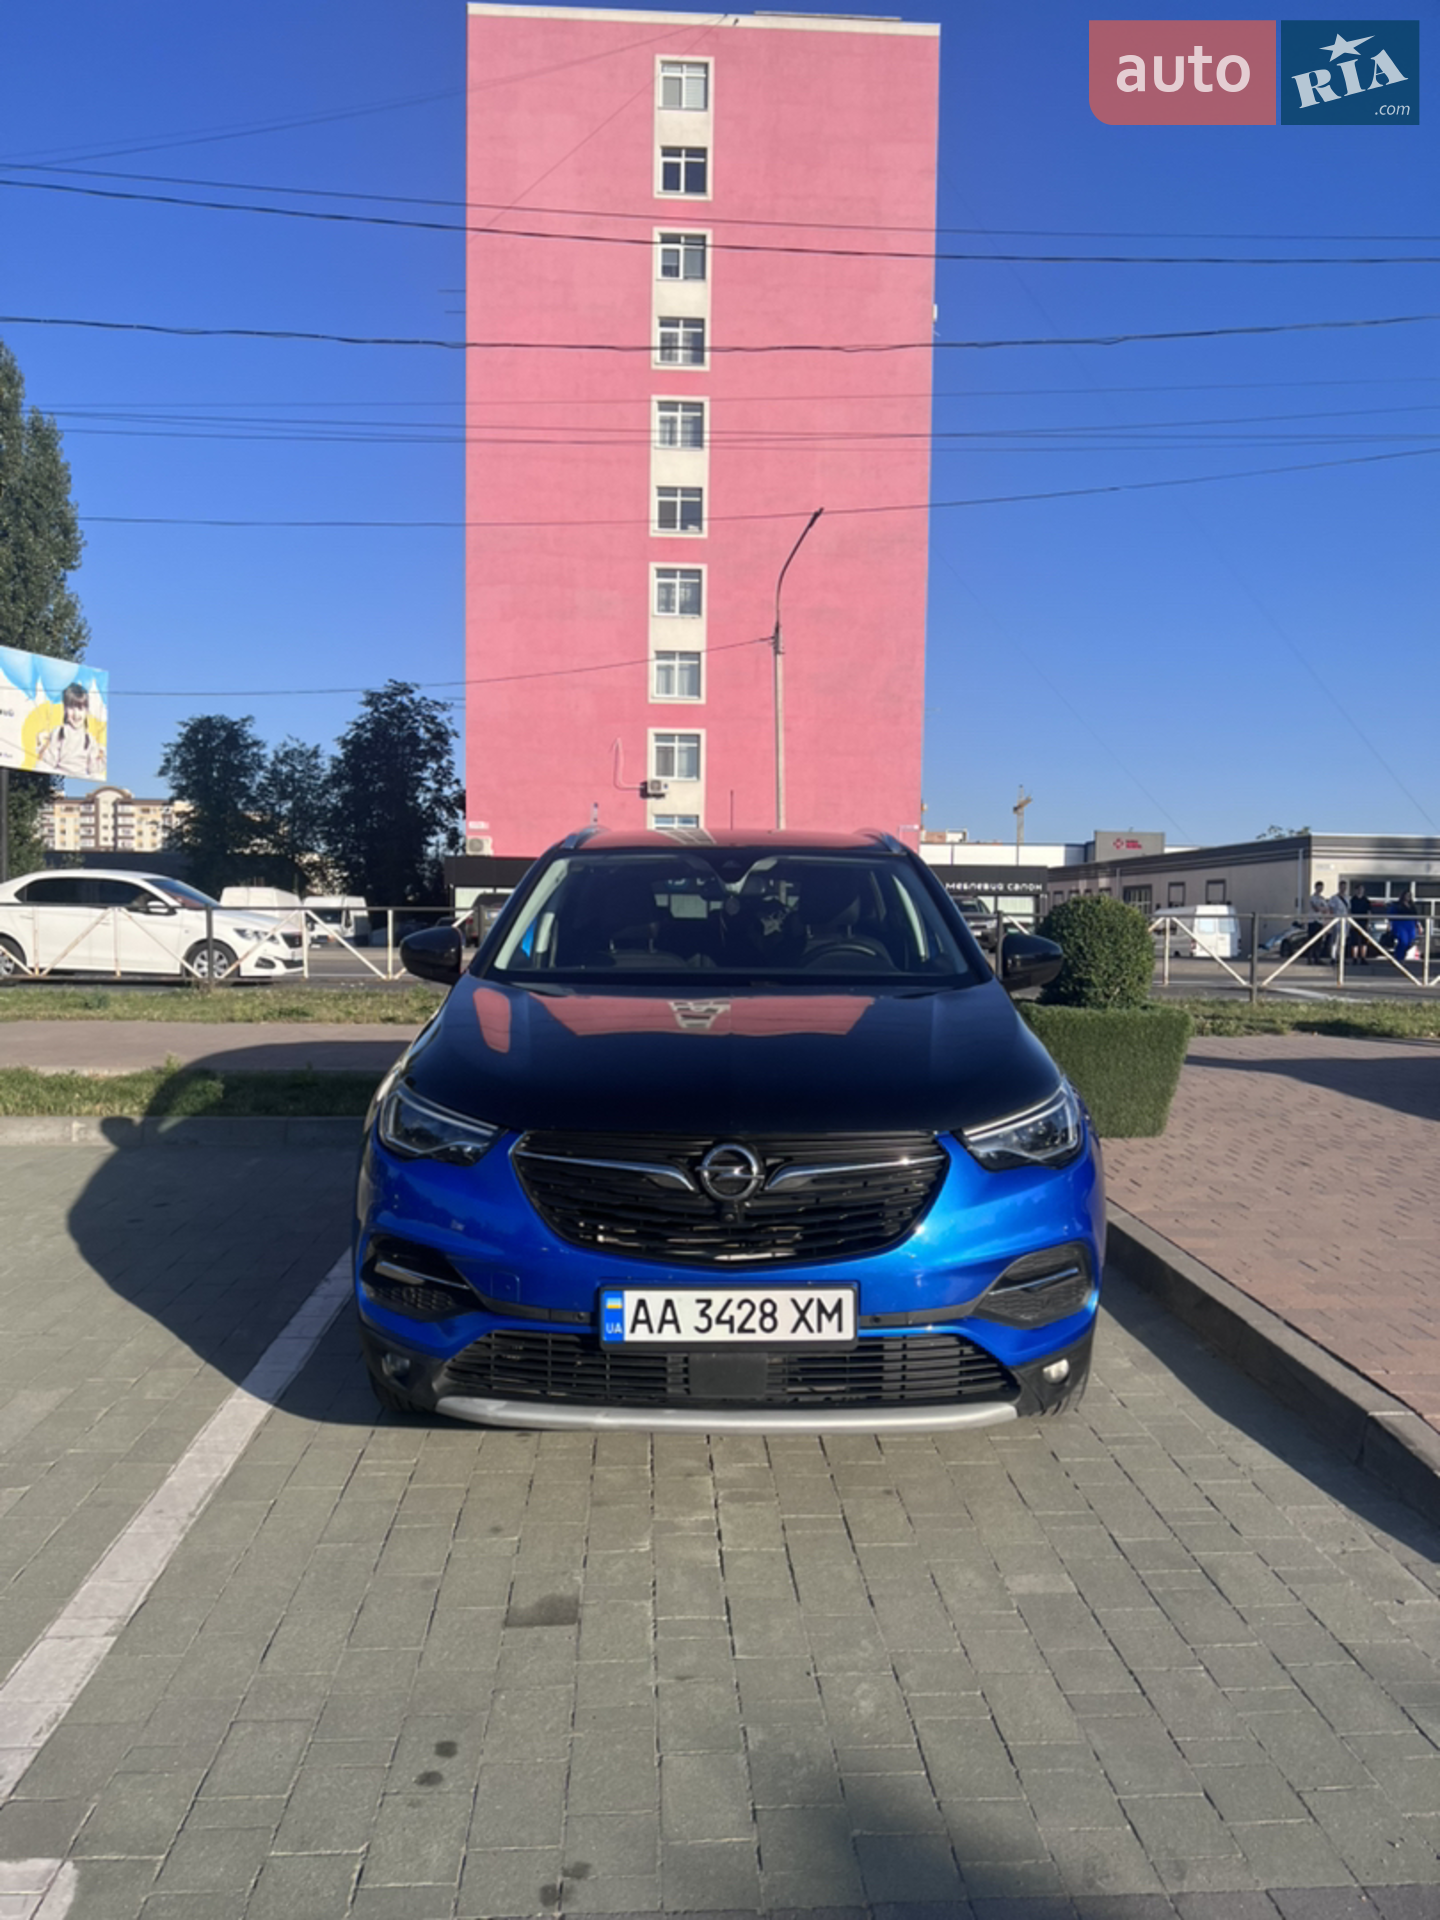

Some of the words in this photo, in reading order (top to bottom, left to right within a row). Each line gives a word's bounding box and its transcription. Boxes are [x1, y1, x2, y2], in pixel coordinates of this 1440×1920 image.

[605, 1322, 623, 1335] UA
[629, 1297, 682, 1335] AA
[693, 1297, 779, 1335] 3428
[790, 1297, 843, 1335] XM
